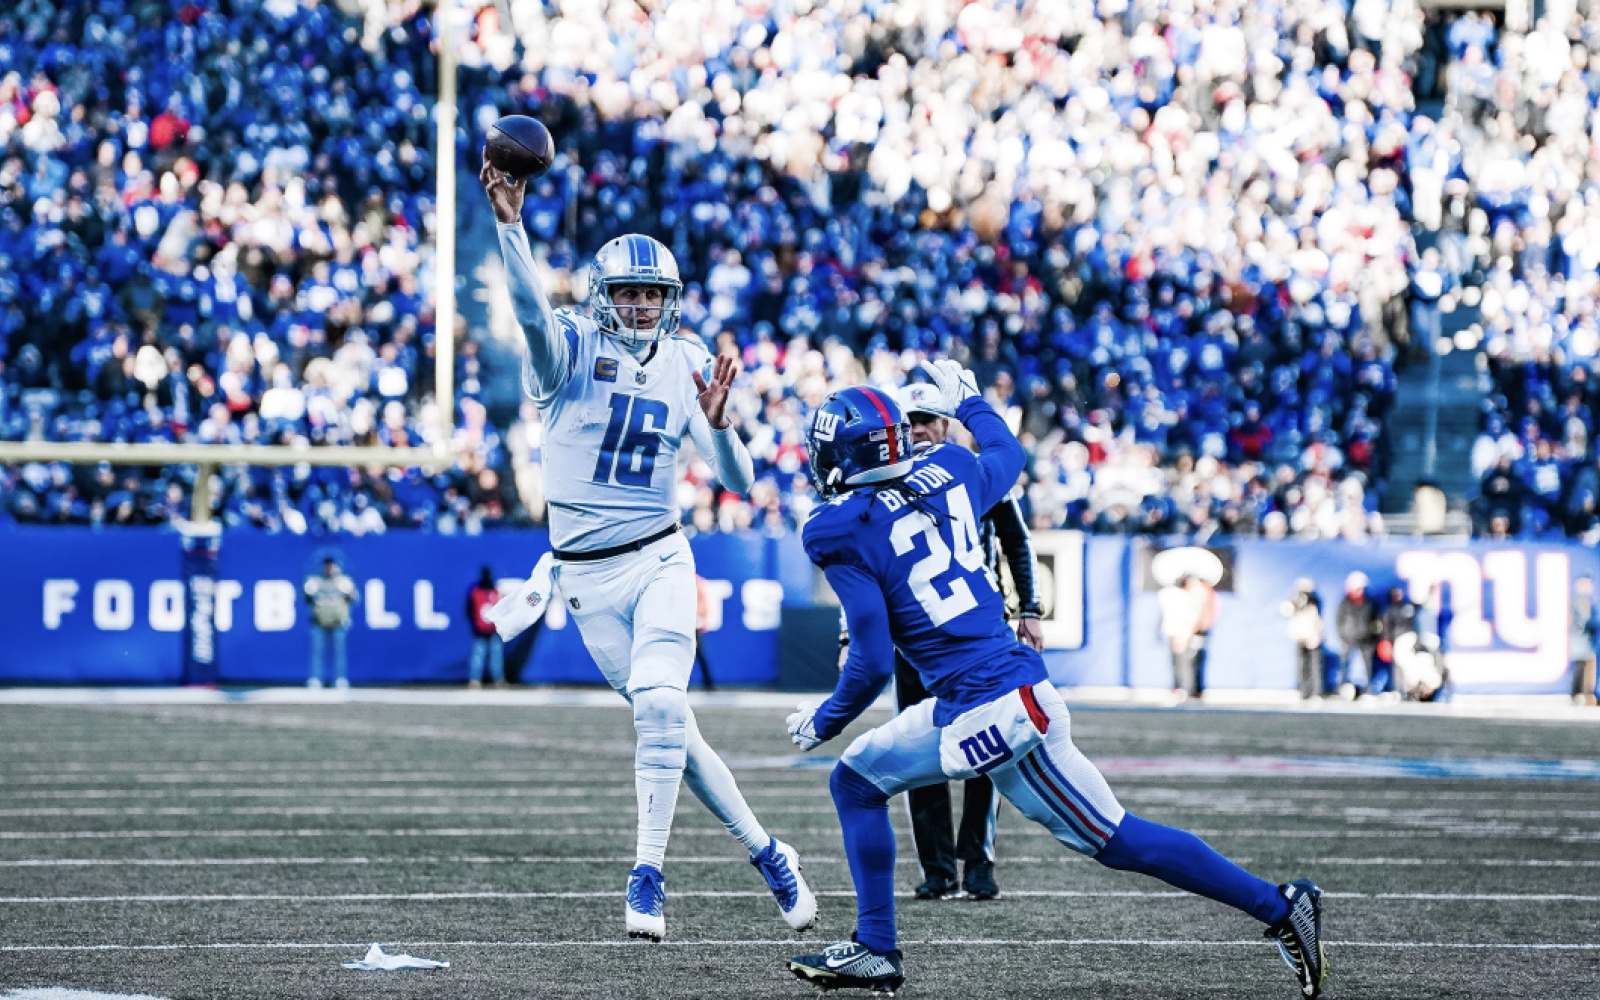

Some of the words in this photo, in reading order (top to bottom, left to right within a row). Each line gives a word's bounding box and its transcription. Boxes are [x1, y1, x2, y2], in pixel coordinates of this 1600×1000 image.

[592, 392, 669, 488] 16
[889, 483, 1000, 628] 24
[42, 578, 450, 631] FOOTBLL
